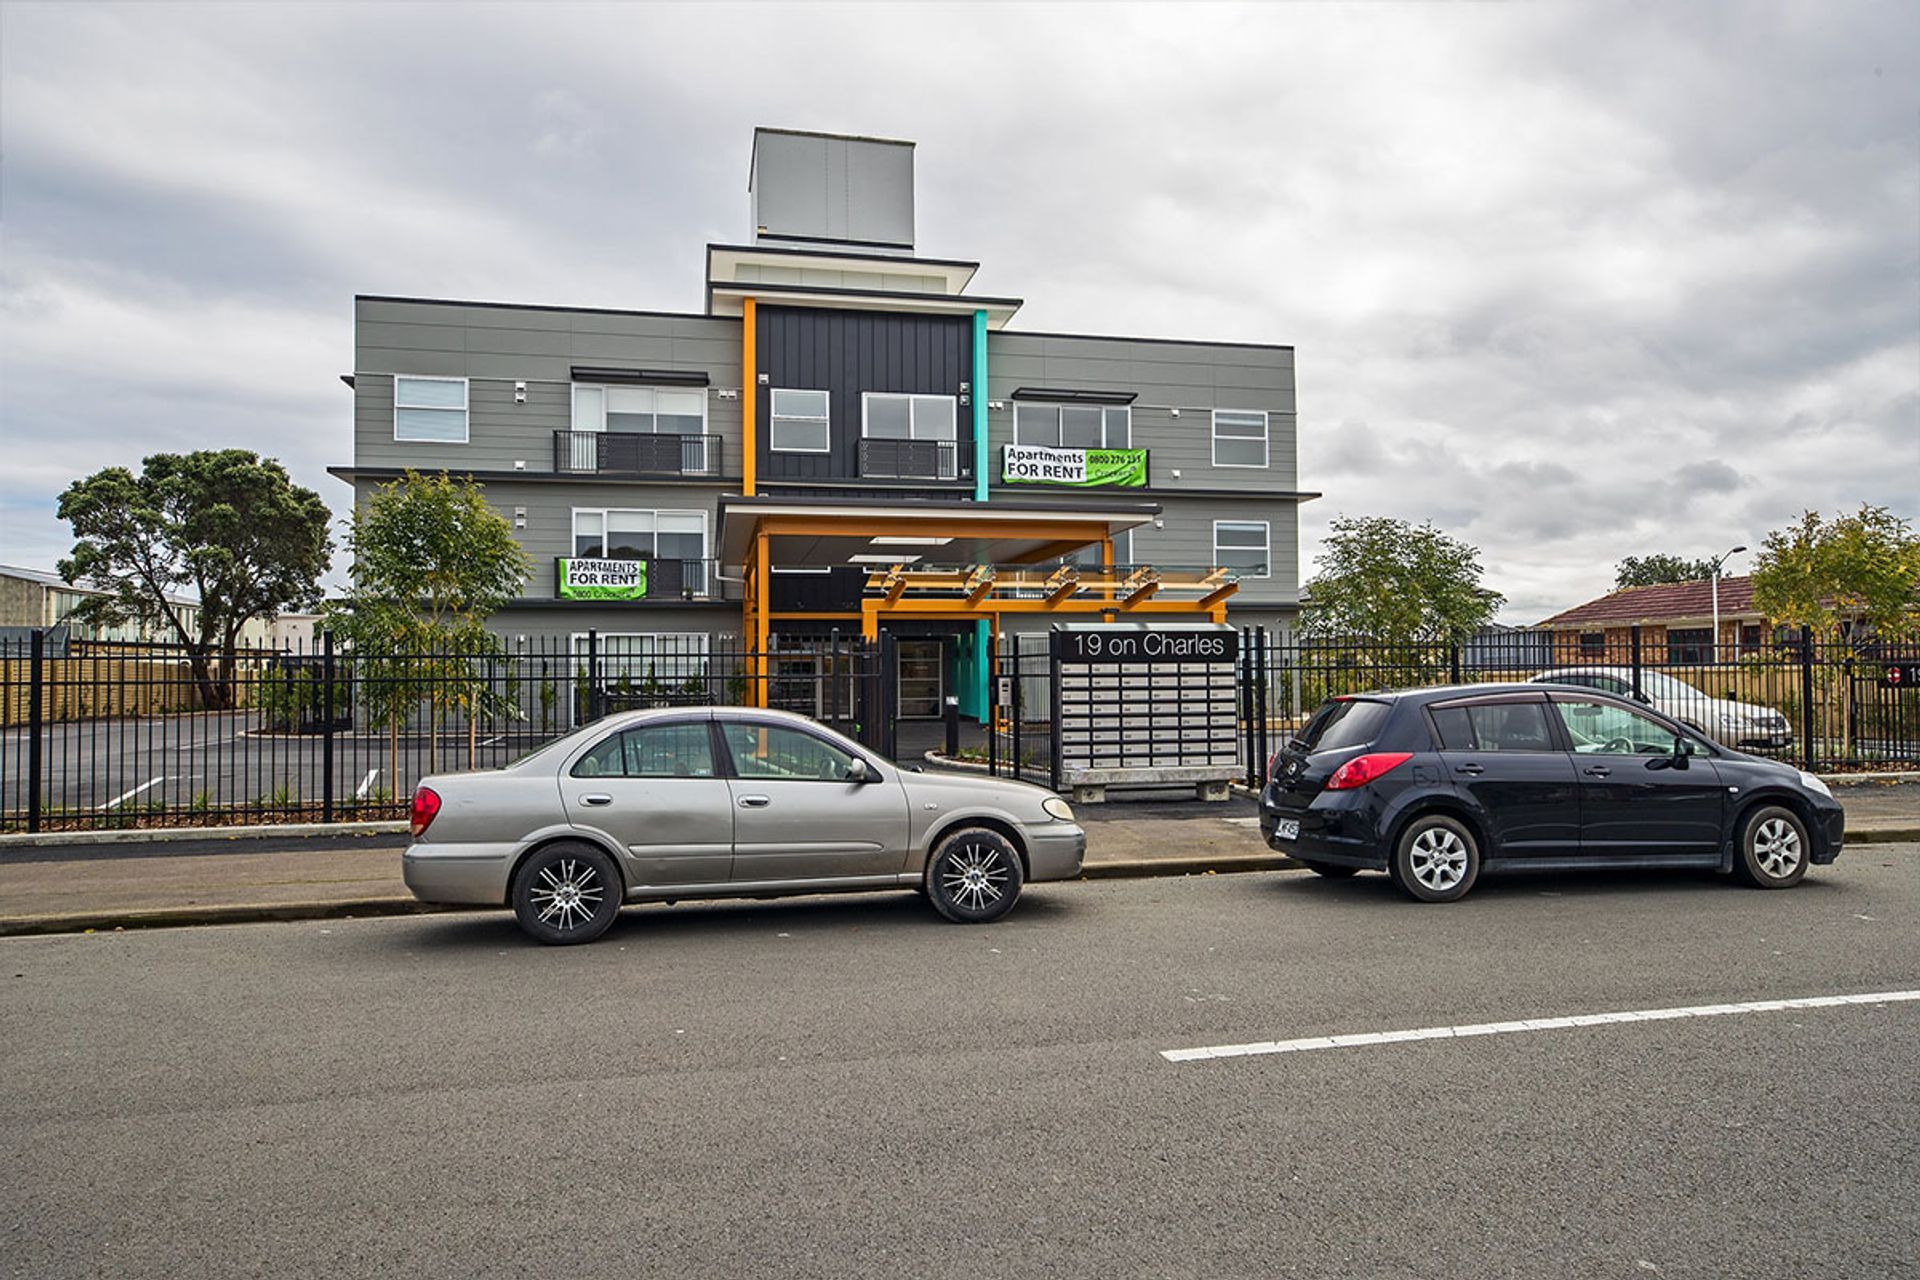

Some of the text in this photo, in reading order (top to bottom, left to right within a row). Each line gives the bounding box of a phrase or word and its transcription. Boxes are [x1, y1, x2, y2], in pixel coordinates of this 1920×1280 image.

[1008, 448, 1083, 463] Apartments
[1008, 463, 1083, 479] FOR RENT
[570, 560, 638, 573] APARTMENTS
[570, 573, 637, 585] FOR RENT
[1074, 632, 1225, 656] 19 on Charles
